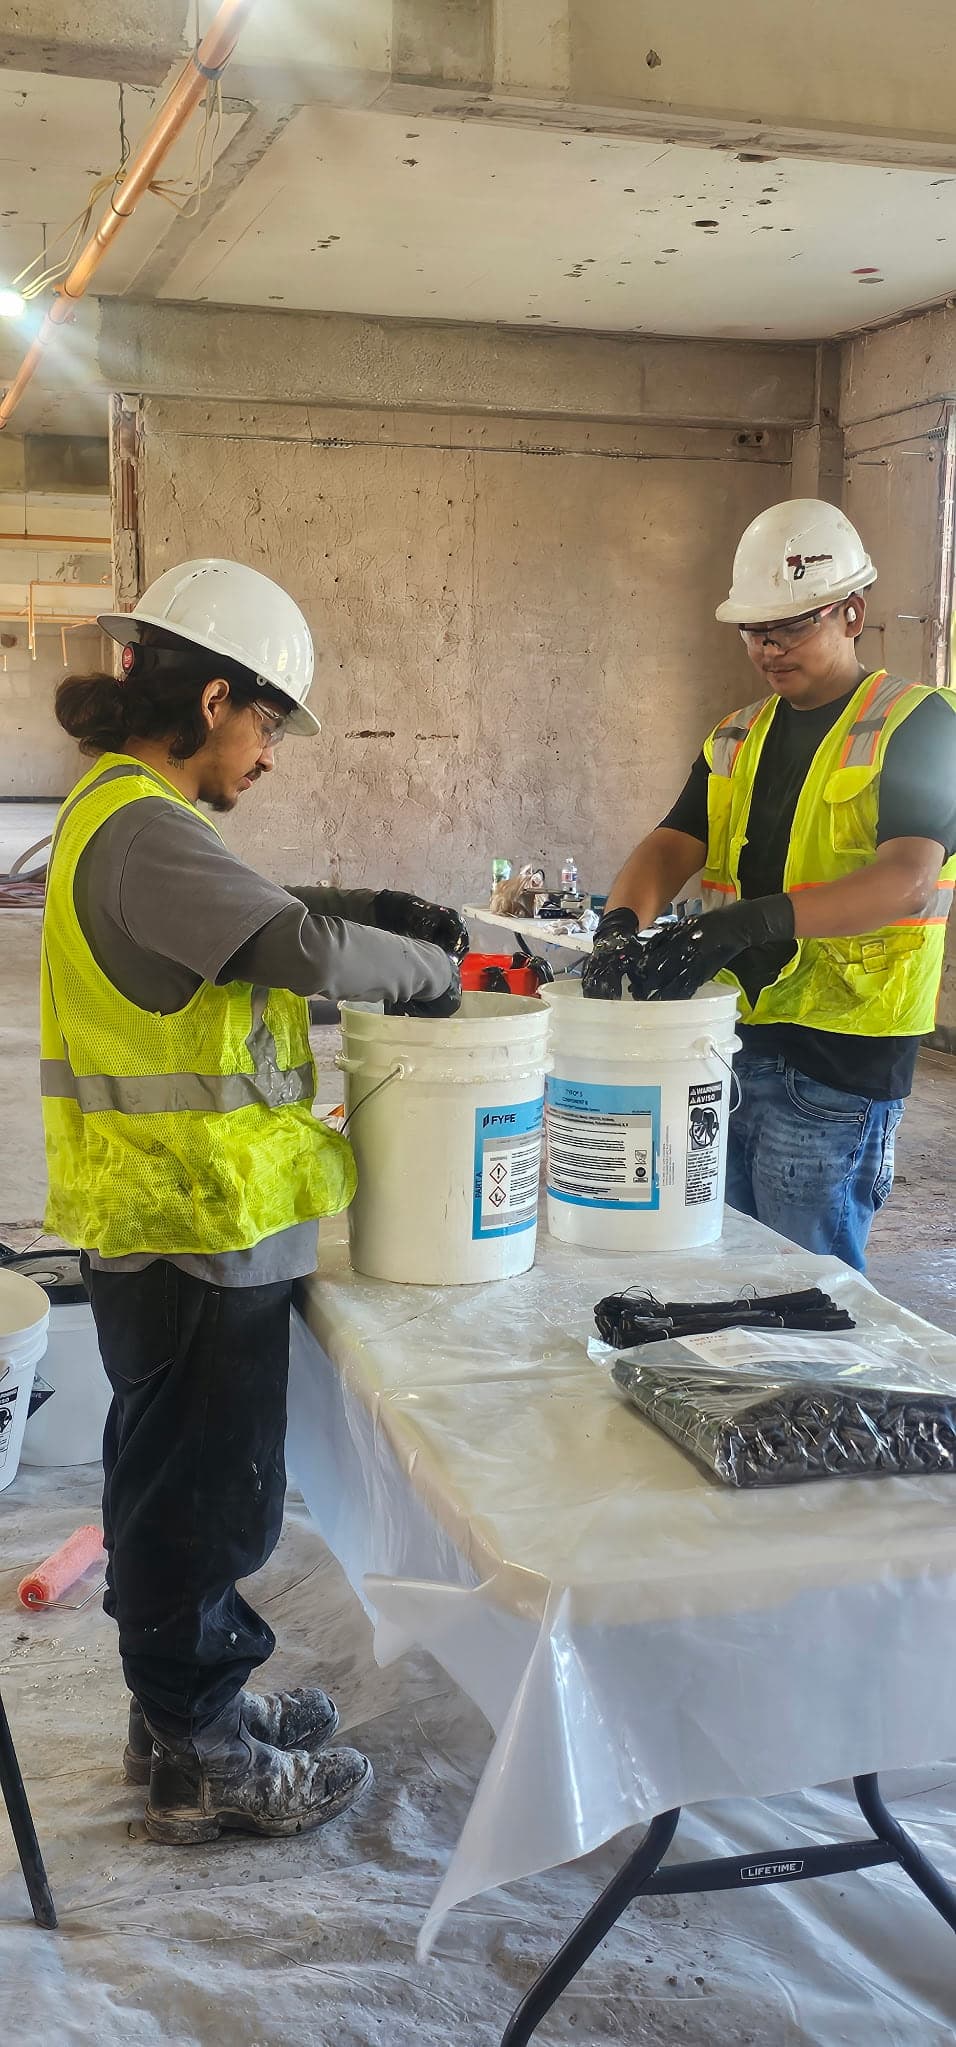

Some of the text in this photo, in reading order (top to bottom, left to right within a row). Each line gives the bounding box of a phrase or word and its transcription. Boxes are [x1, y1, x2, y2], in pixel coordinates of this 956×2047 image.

[696, 1093, 716, 1104] AVISO
[491, 1112, 517, 1125] FYFE
[475, 1171, 483, 1199] PART A
[748, 1863, 797, 1877] LIFETIME
